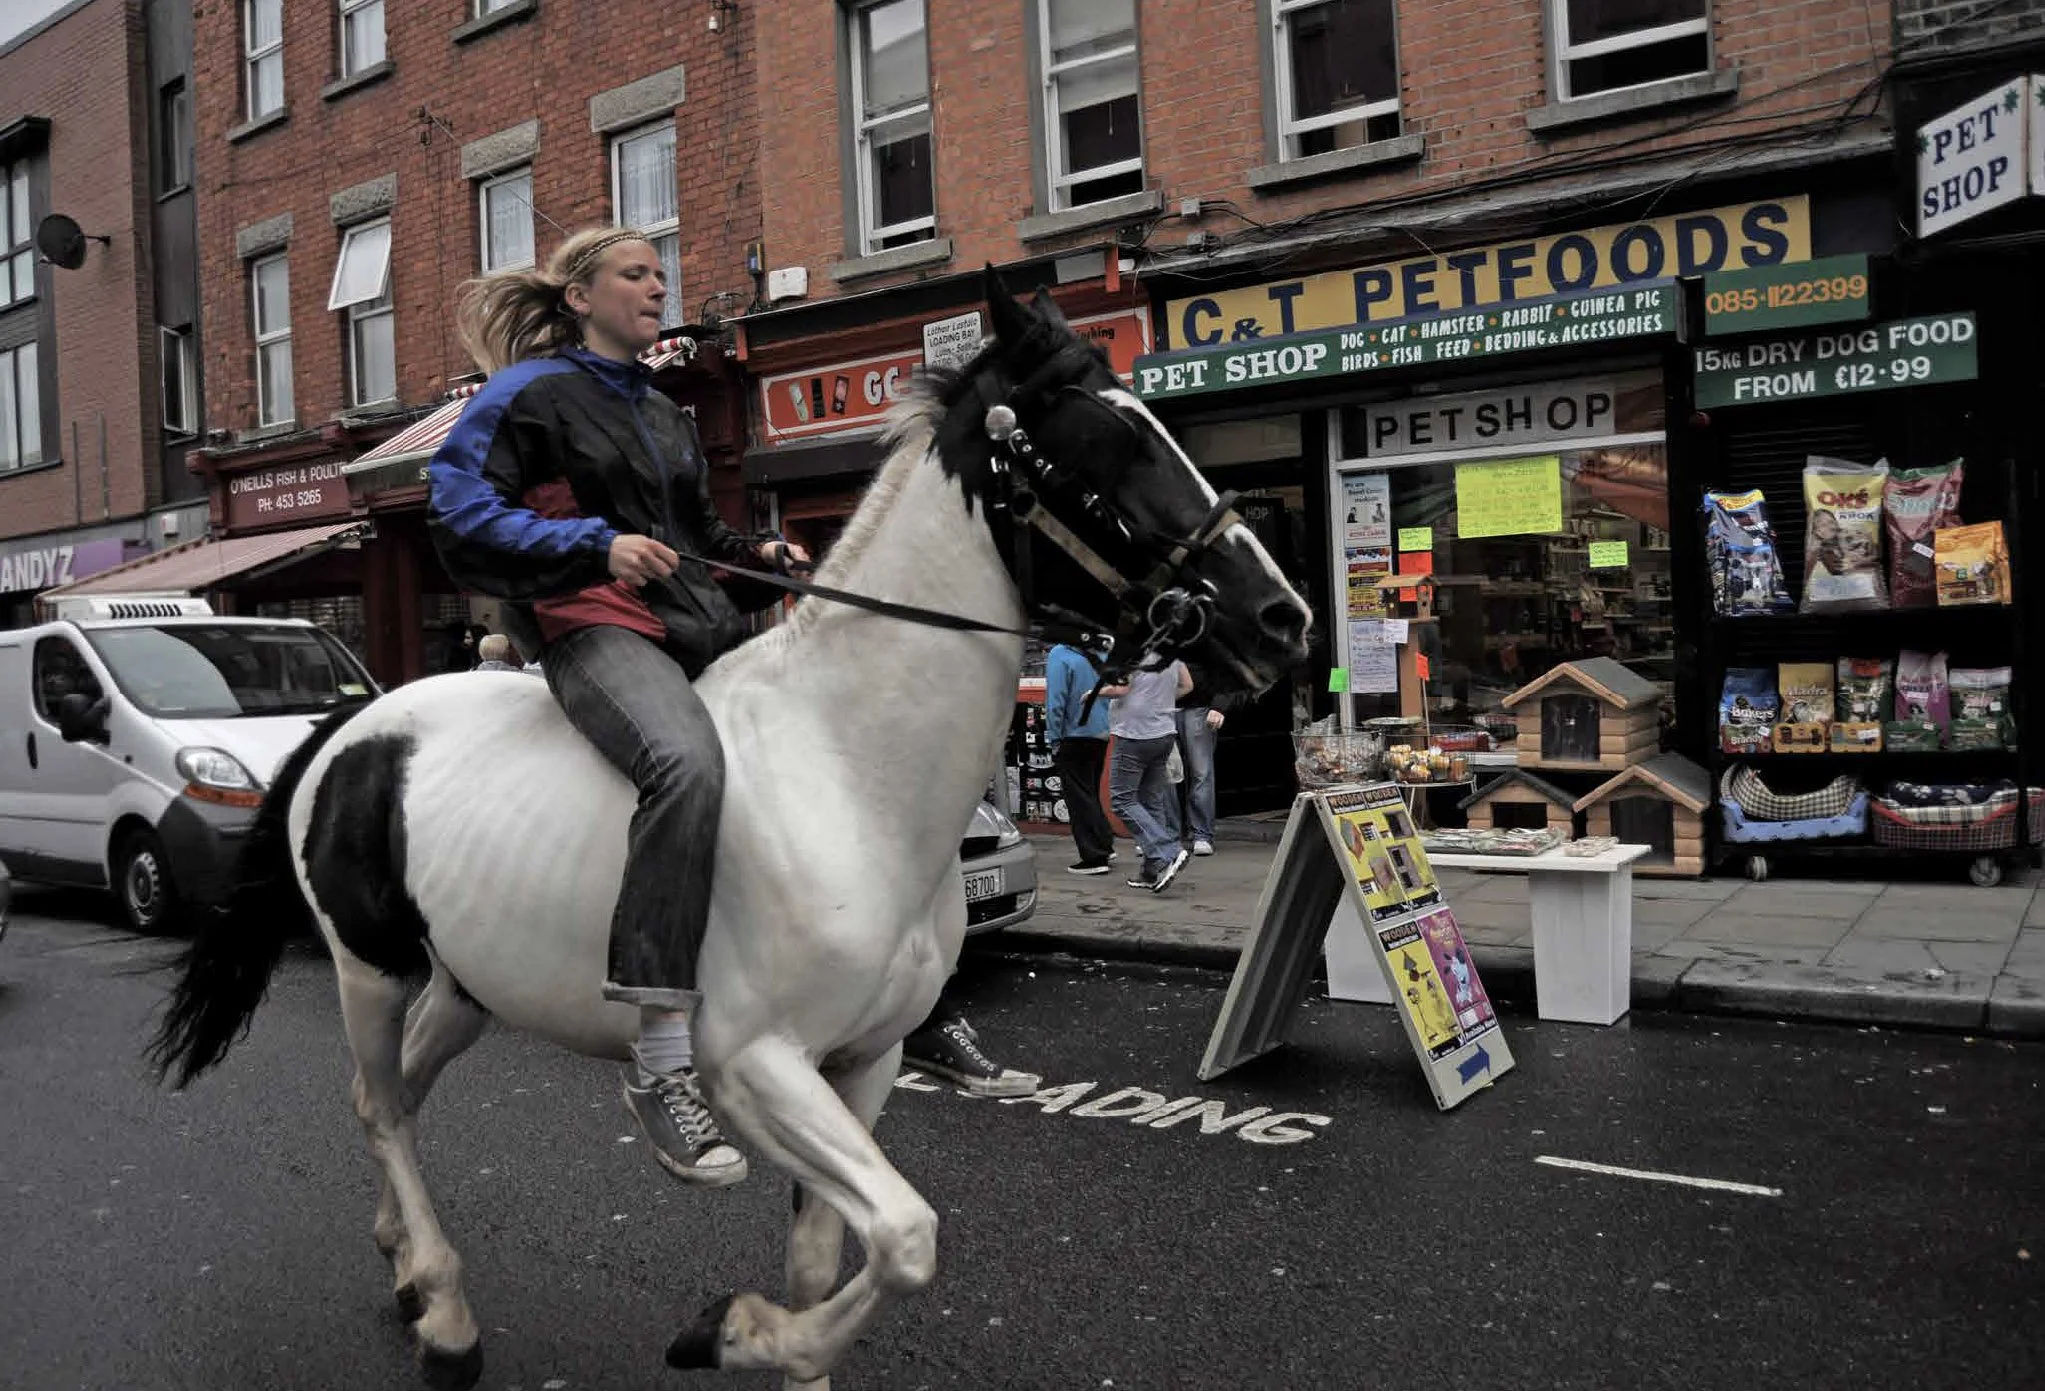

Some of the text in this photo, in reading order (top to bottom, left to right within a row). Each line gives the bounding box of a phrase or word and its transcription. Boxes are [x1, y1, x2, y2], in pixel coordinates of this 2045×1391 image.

[1933, 104, 1999, 165] PET
[1923, 156, 2009, 220] SHOP
[1183, 203, 1789, 347] C & T PETFOODS
[929, 329, 975, 348] LOADING BAY
[1341, 290, 1660, 350] DOG CAT HAMSTER RABBIT GUINEA PIG
[1342, 351, 1379, 371] BIRDS
[1392, 345, 1422, 364] FISH
[1436, 338, 1471, 359] FEED
[1485, 329, 1546, 352] BEDDING
[1562, 313, 1663, 343] ACCESSORIES
[1748, 339, 1807, 367] DRY
[1817, 331, 1880, 359] DOG
[1889, 318, 1975, 350] FOOD
[1140, 343, 1327, 394] PET SHOP
[1734, 371, 1816, 400] FROM
[276, 470, 297, 486] FISH
[300, 469, 307, 483] &
[276, 493, 294, 509] 453
[297, 489, 321, 506] 5265
[965, 875, 995, 898] 68700
[1381, 923, 1418, 943] WOODEN
[893, 1071, 1333, 1144] LADING
